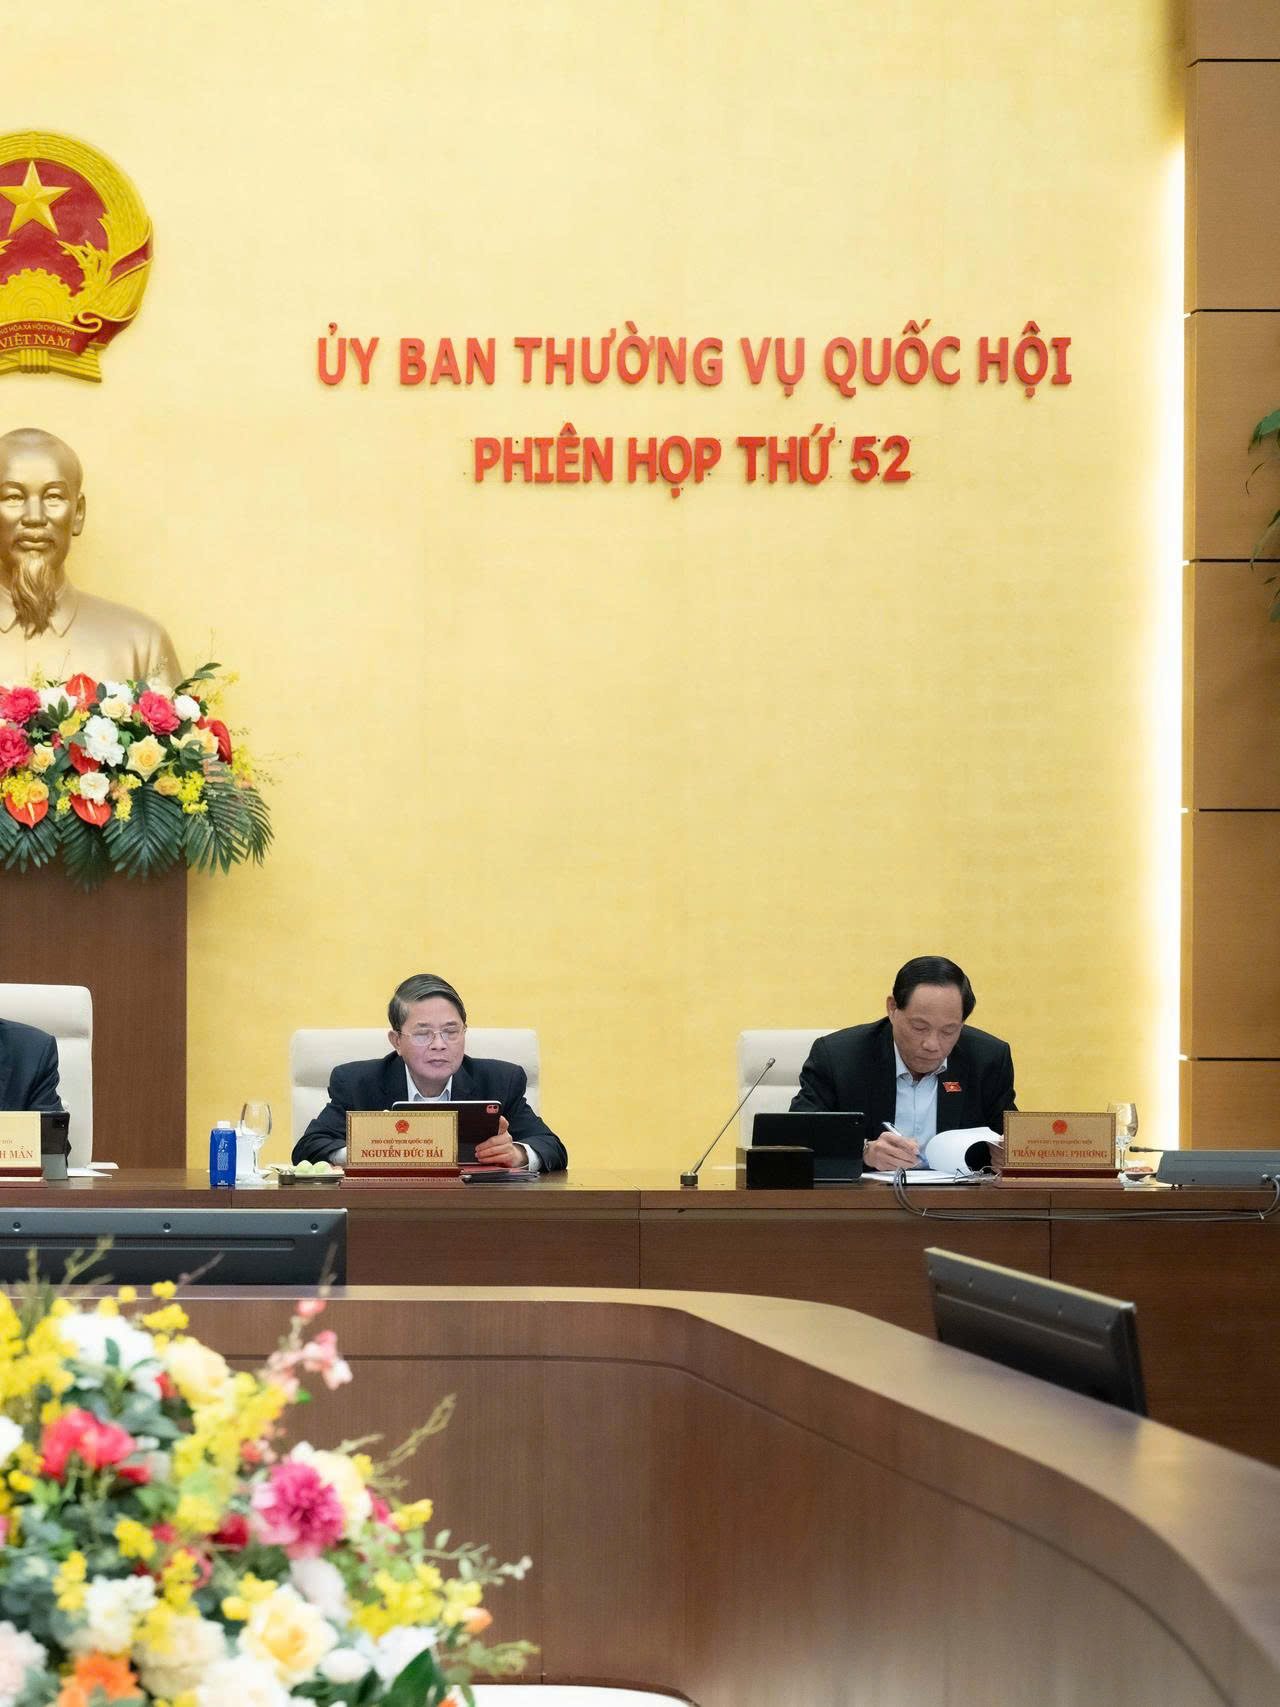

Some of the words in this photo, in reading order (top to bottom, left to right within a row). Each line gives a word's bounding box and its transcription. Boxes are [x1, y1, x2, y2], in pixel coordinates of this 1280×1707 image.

[34, 334, 71, 348] NAM
[318, 322, 380, 385] ỦY
[400, 337, 496, 385] BAN
[514, 320, 723, 385] THƯỜNG
[740, 337, 805, 397] VỤ
[824, 319, 961, 397] QUỐC
[979, 320, 1073, 397] HỘI
[474, 422, 613, 484] PHIÊN
[627, 436, 721, 498] HỌP
[737, 423, 836, 484] THỨ
[850, 435, 912, 483] 52
[361, 1145, 401, 1158] NGUYỄN
[403, 1147, 424, 1158] ĐỨC
[426, 1146, 444, 1158] HẢI
